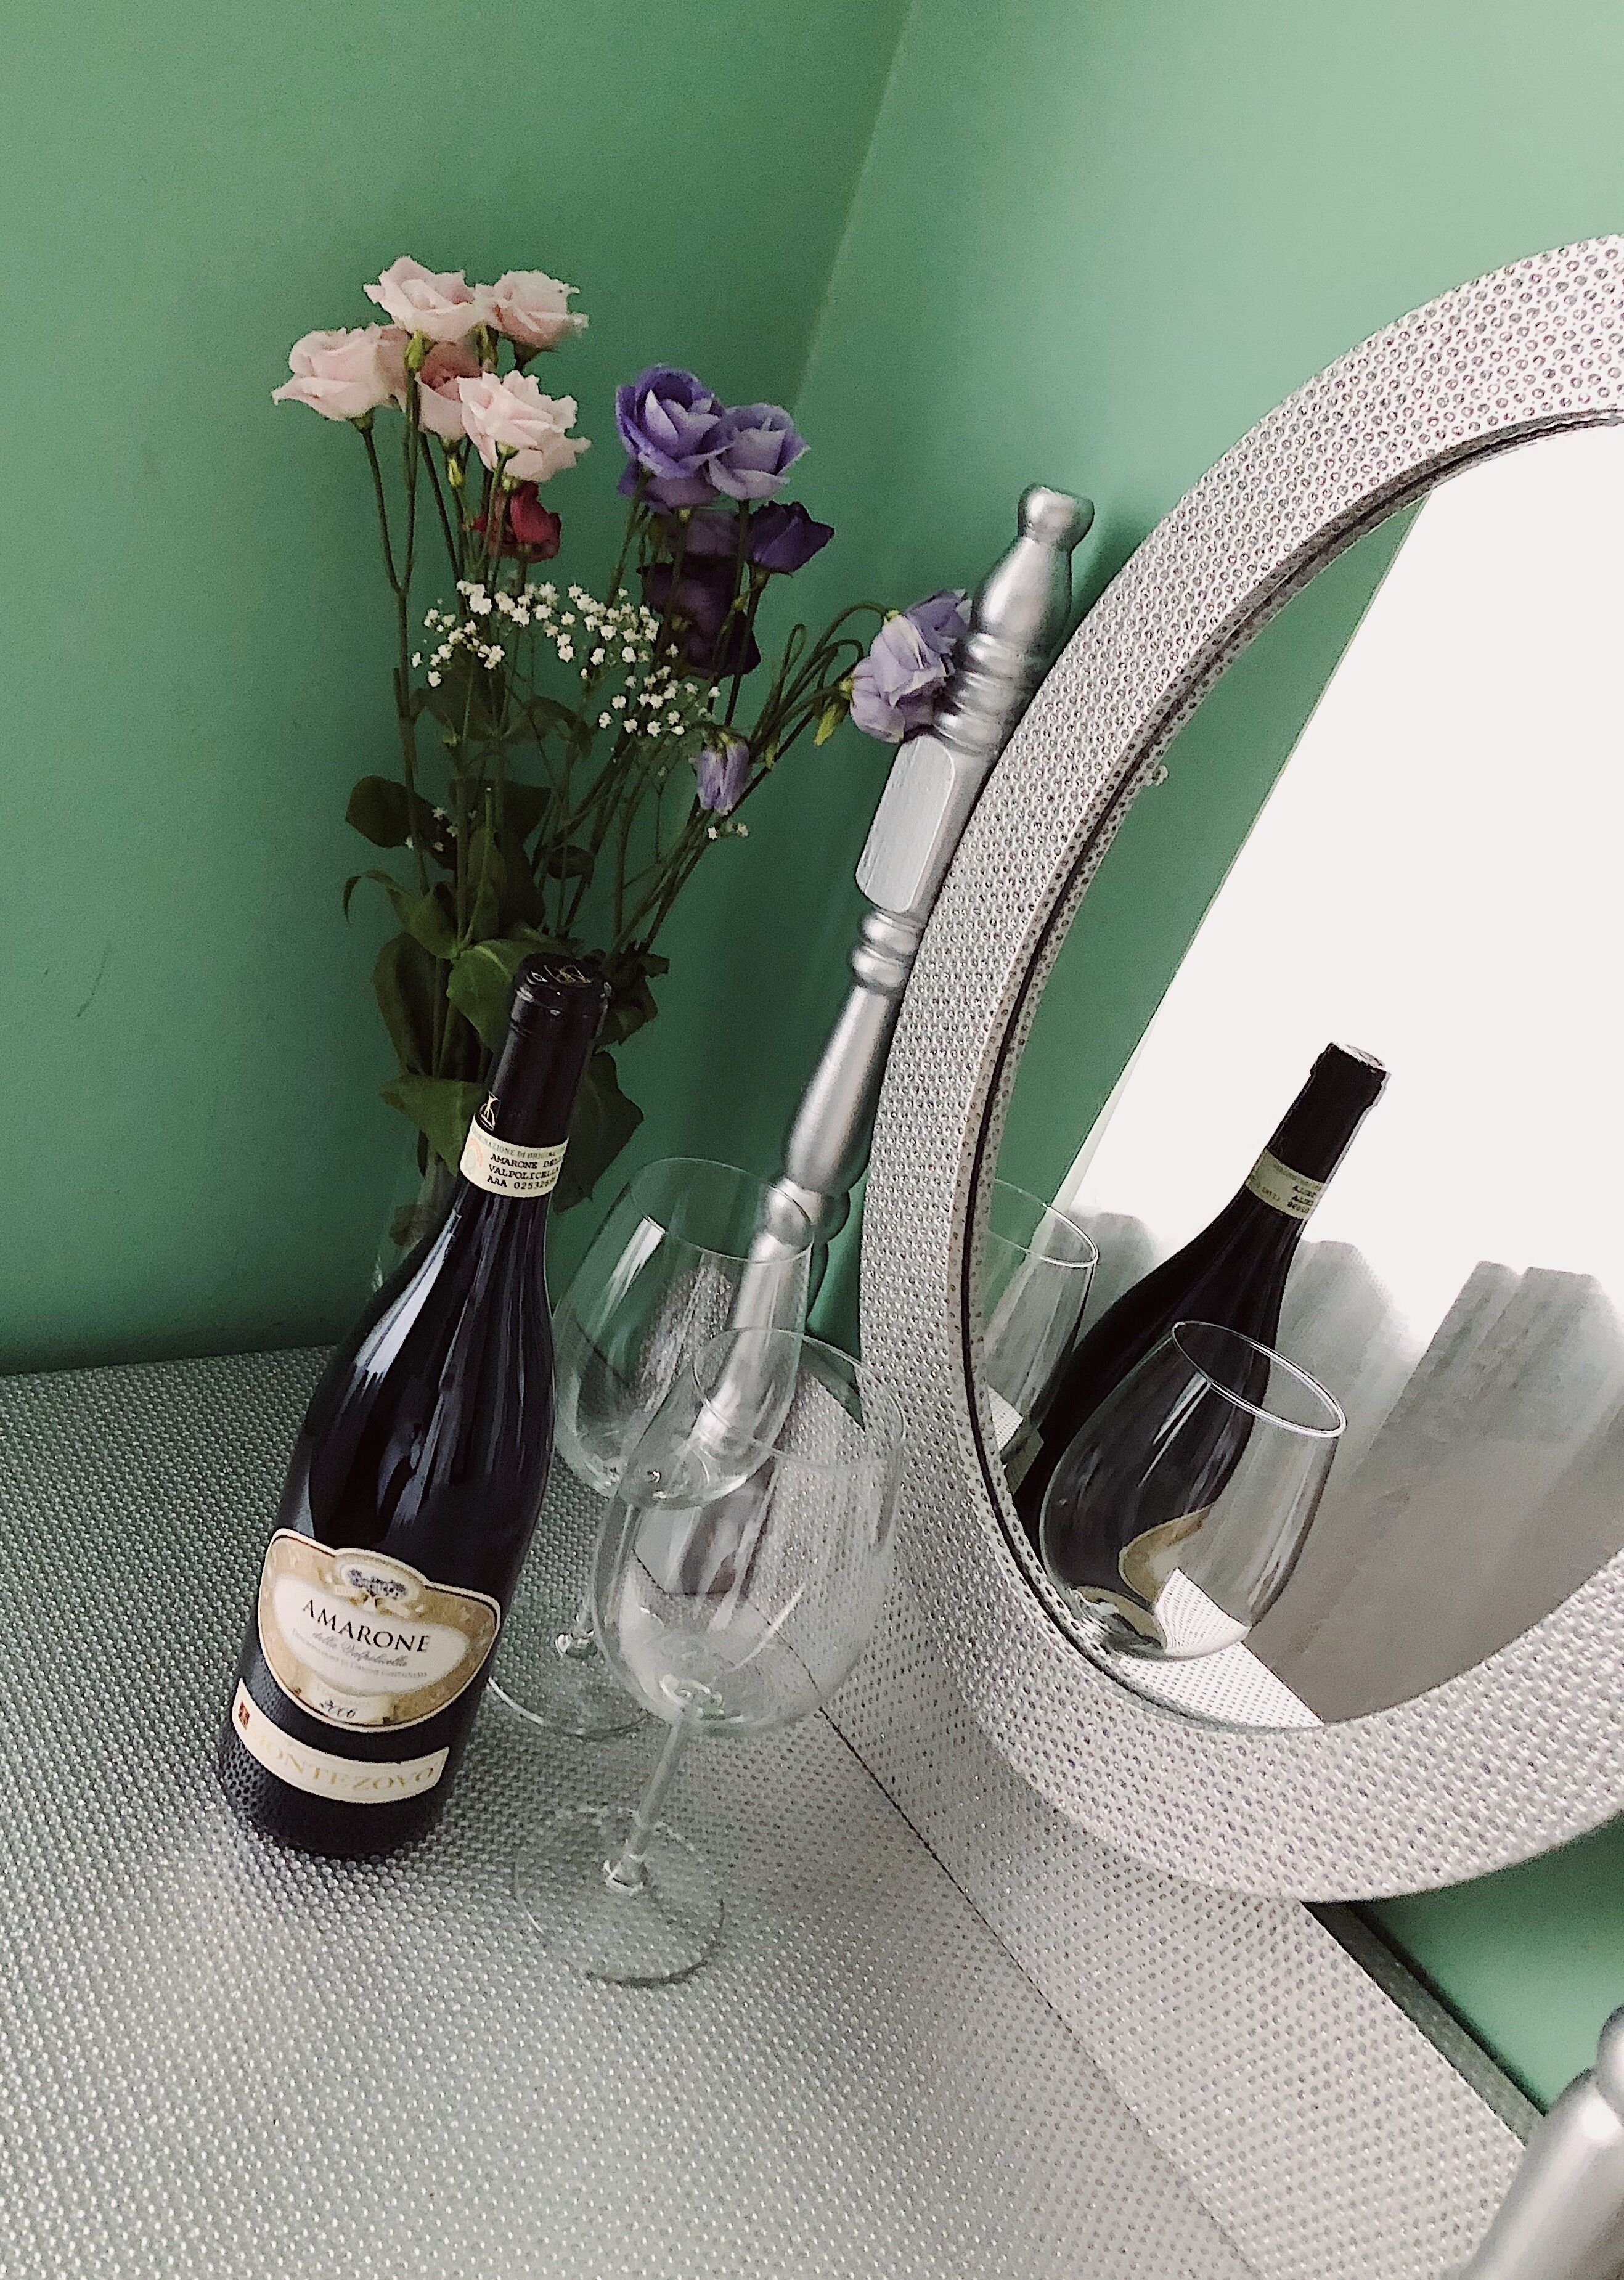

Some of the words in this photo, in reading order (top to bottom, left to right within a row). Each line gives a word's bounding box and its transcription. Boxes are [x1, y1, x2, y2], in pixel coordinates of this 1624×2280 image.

[490, 1153, 538, 1169] AMARONE
[487, 1175, 507, 1188] AAA
[301, 1599, 431, 1652] AMARONE
[250, 1727, 435, 1791] MONTEZOVO
